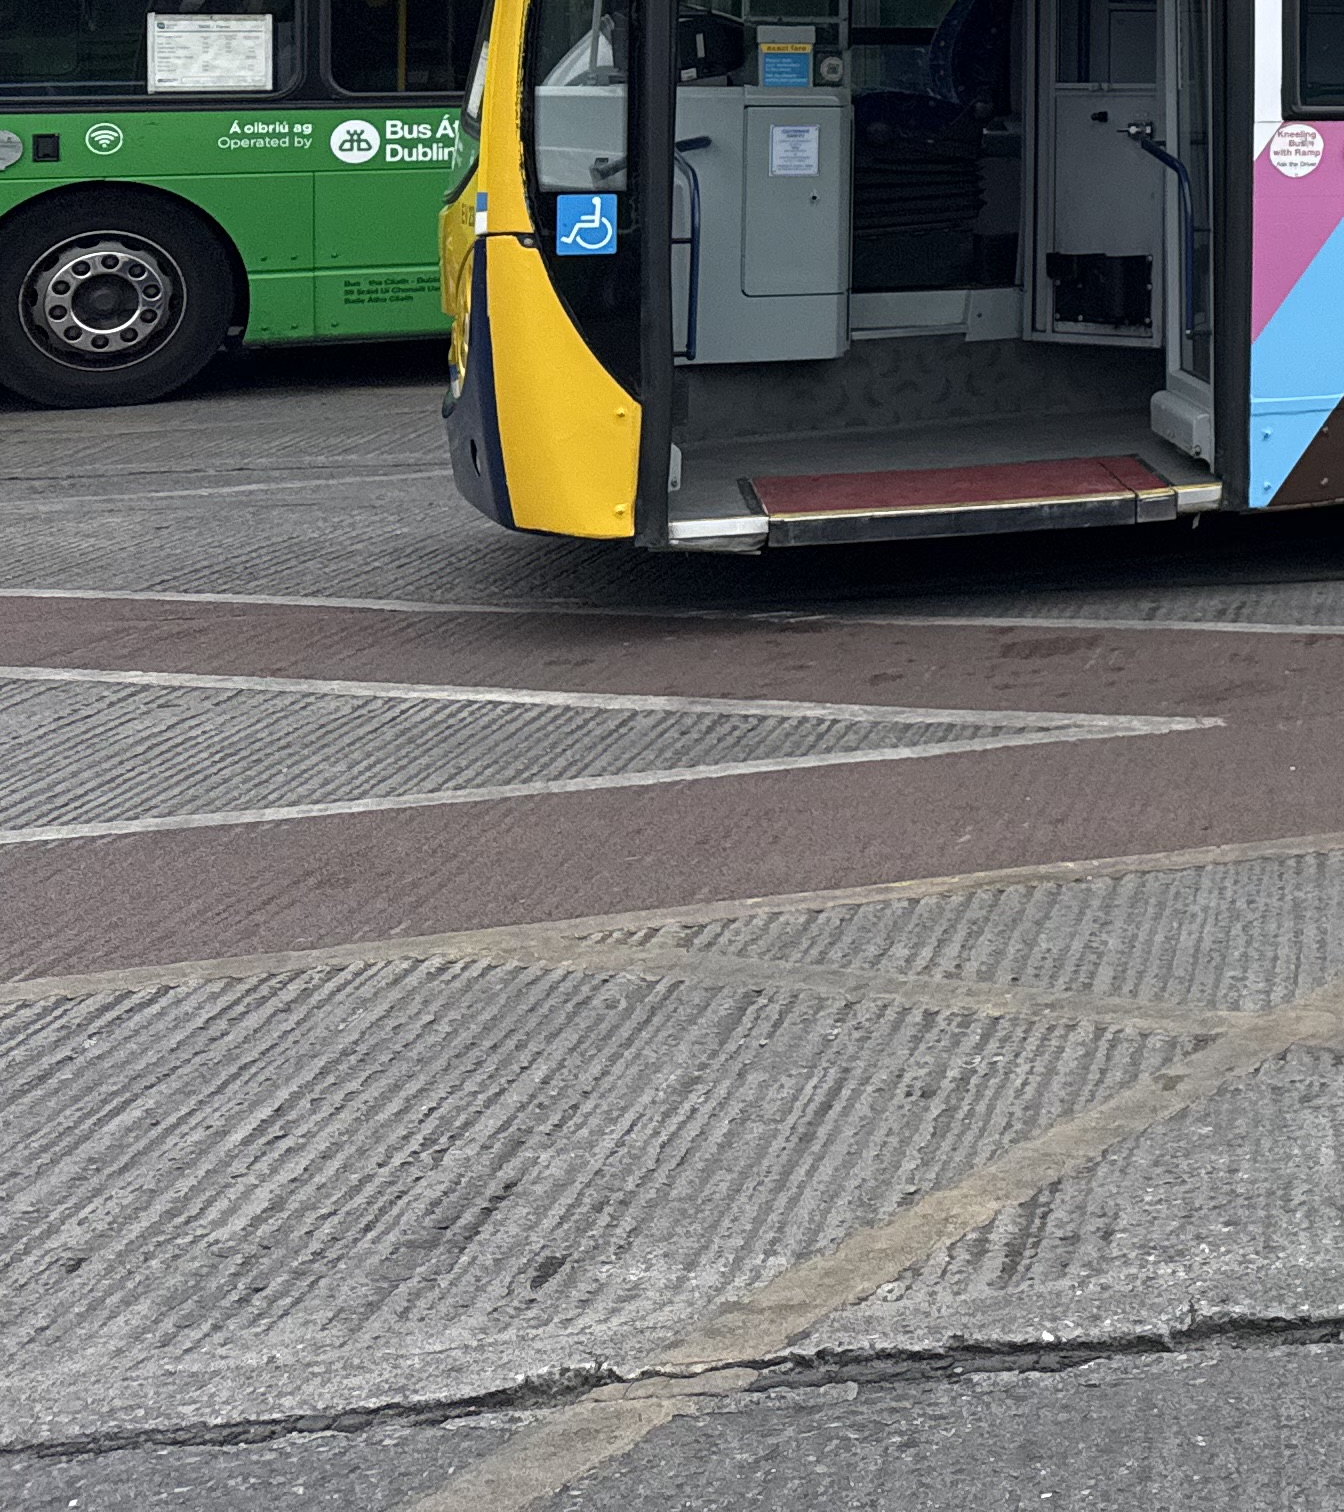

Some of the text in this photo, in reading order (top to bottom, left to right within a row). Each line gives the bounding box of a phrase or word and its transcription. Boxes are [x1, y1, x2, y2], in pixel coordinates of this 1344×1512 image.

[293, 123, 313, 136] ag
[385, 120, 432, 139] Bus
[1277, 130, 1317, 140] Kneeling
[217, 136, 313, 150] Operated by
[1273, 149, 1321, 158] with Ramp
